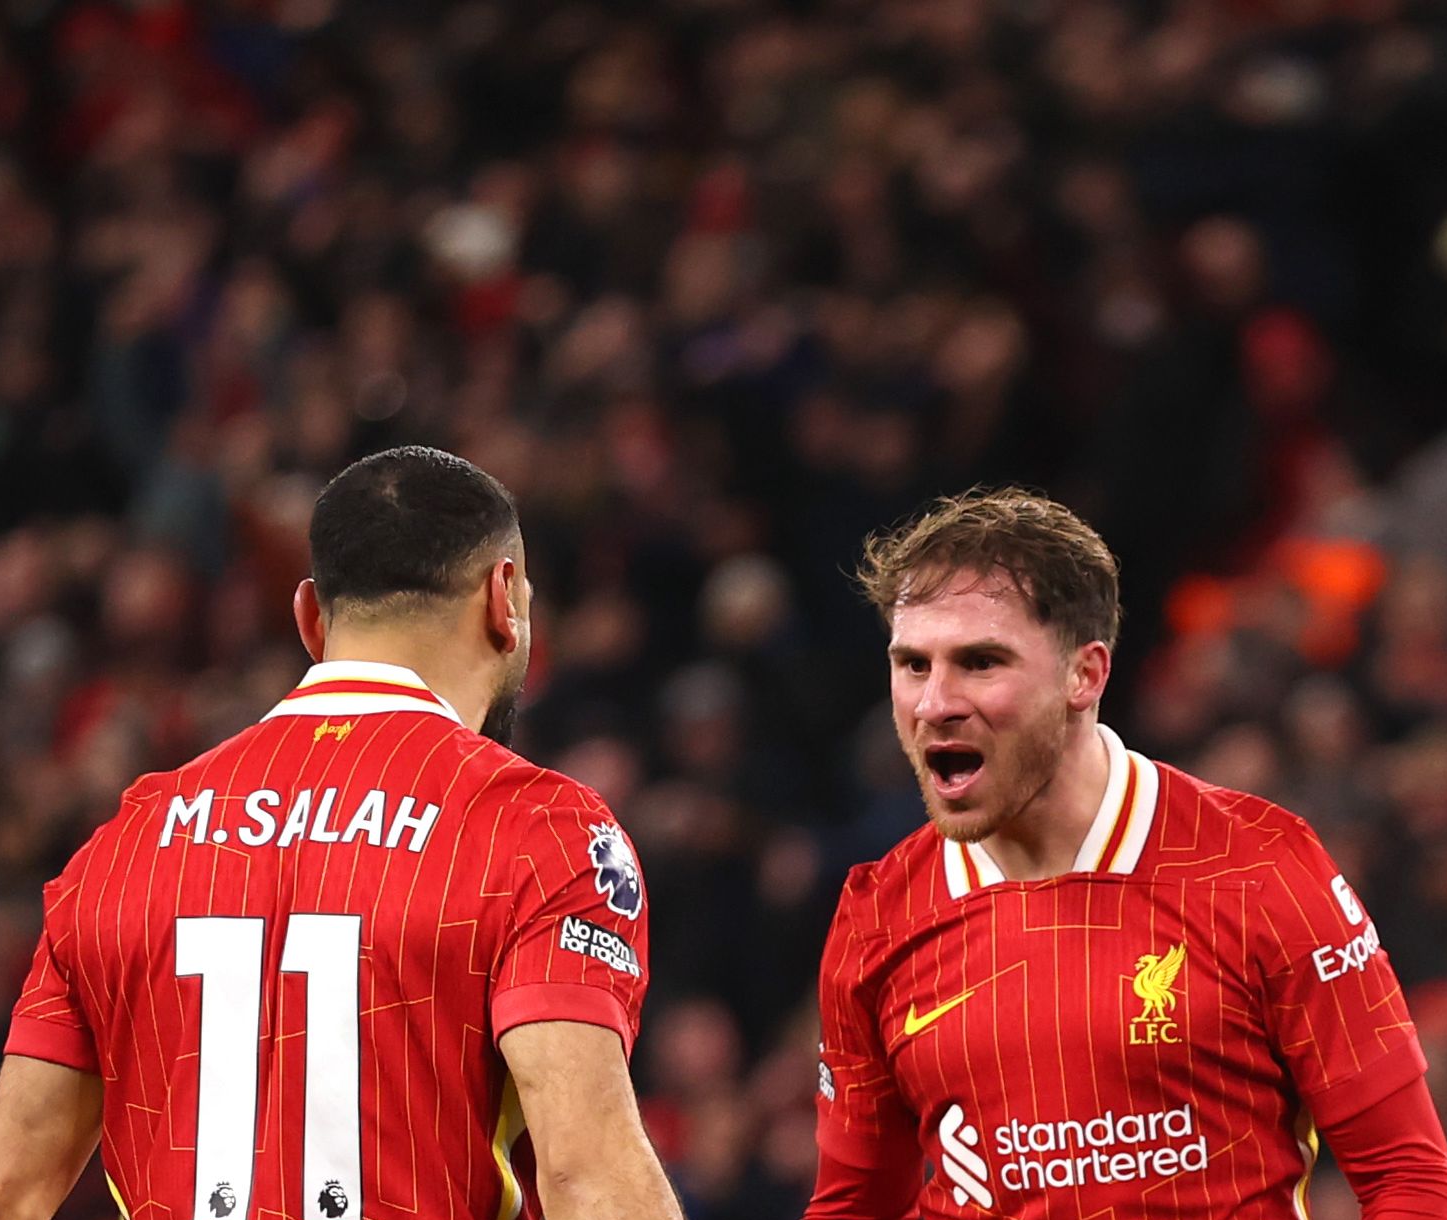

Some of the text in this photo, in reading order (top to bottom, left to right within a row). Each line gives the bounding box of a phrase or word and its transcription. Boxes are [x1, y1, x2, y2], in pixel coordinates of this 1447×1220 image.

[561, 915, 630, 962] No room
[1129, 1022, 1183, 1045] L.F.C.
[994, 1103, 1193, 1155] standard
[1000, 1135, 1208, 1191] chartered
